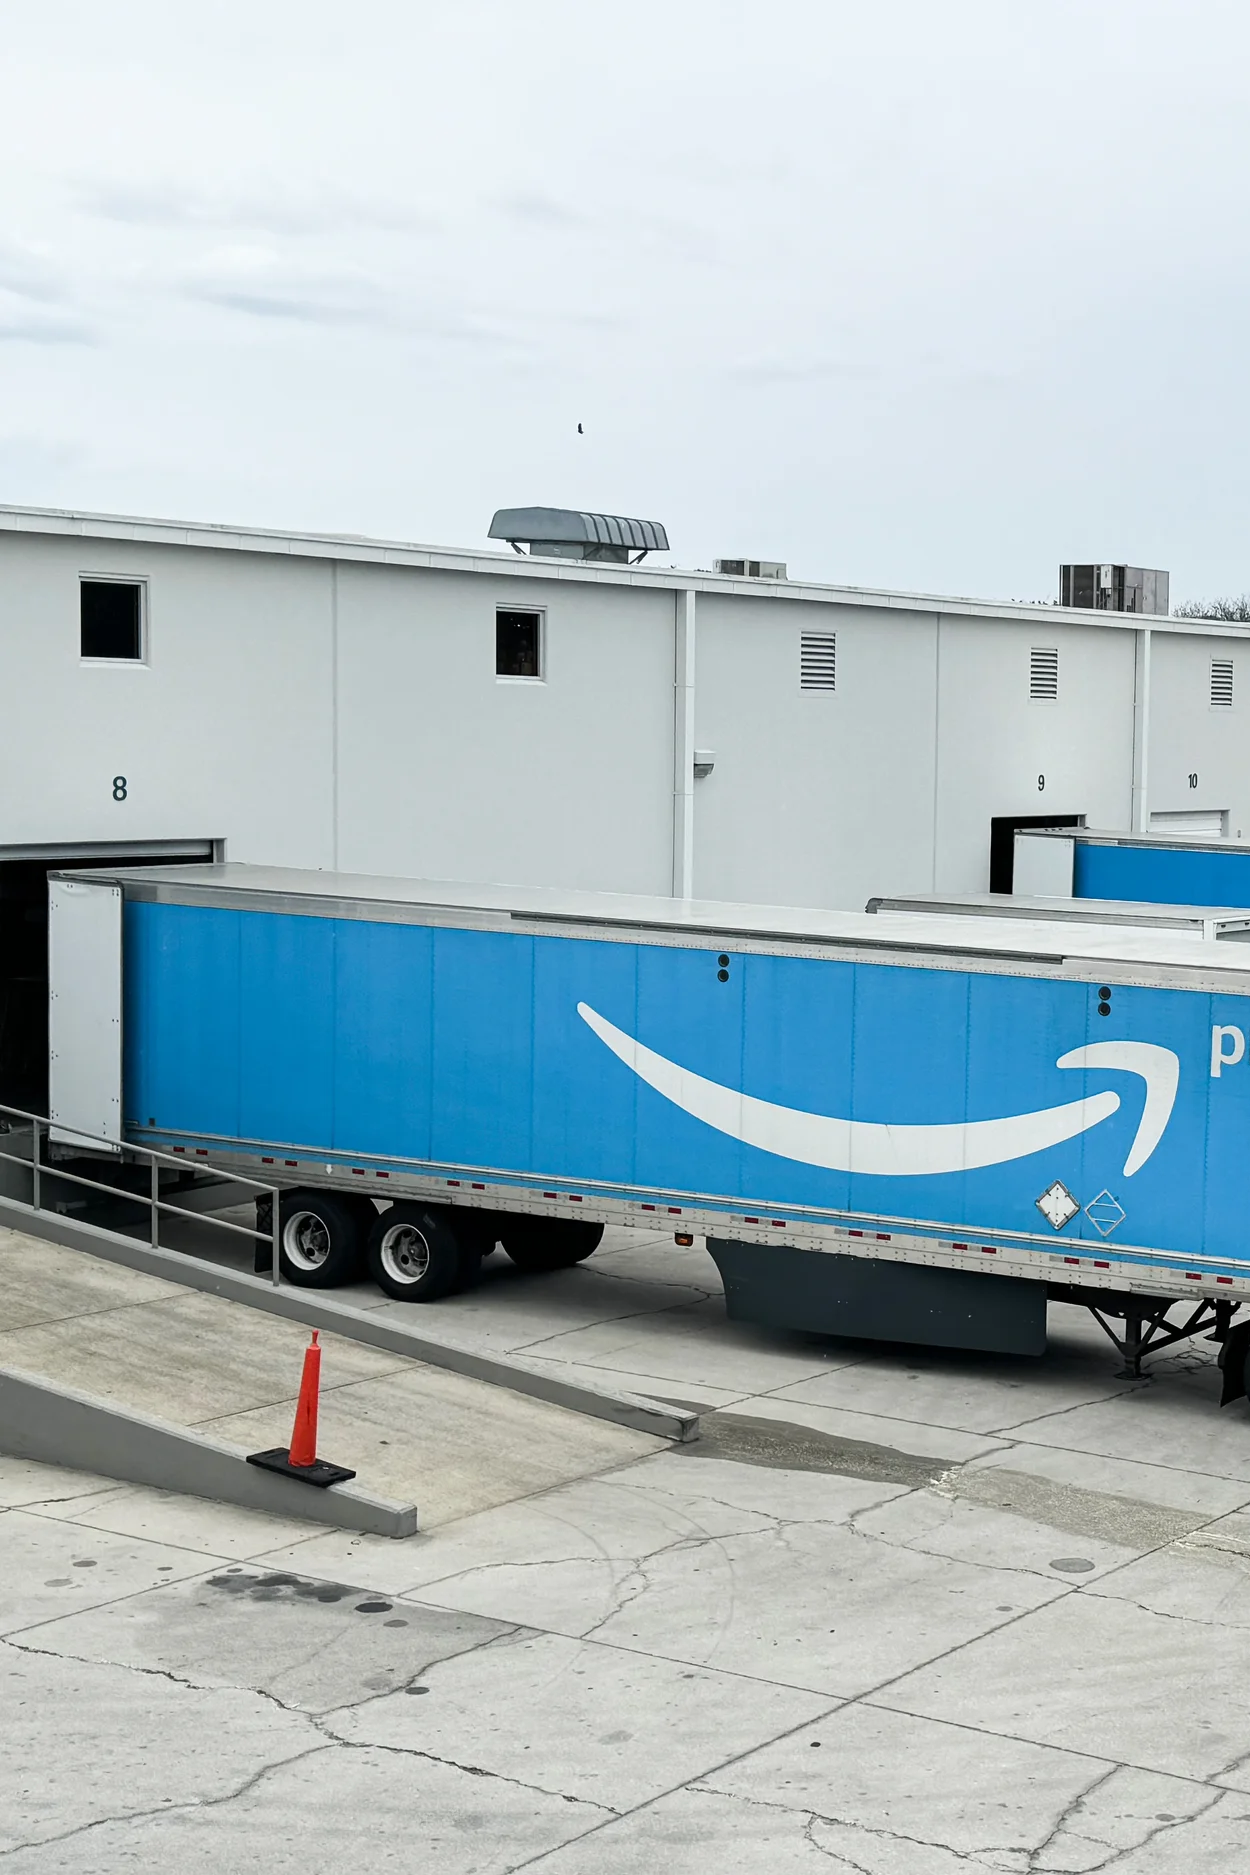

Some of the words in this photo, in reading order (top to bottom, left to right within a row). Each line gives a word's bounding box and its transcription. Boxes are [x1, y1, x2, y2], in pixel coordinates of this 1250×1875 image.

[112, 775, 128, 802] 8
[1038, 774, 1045, 792] 9
[1188, 773, 1198, 789] 10
